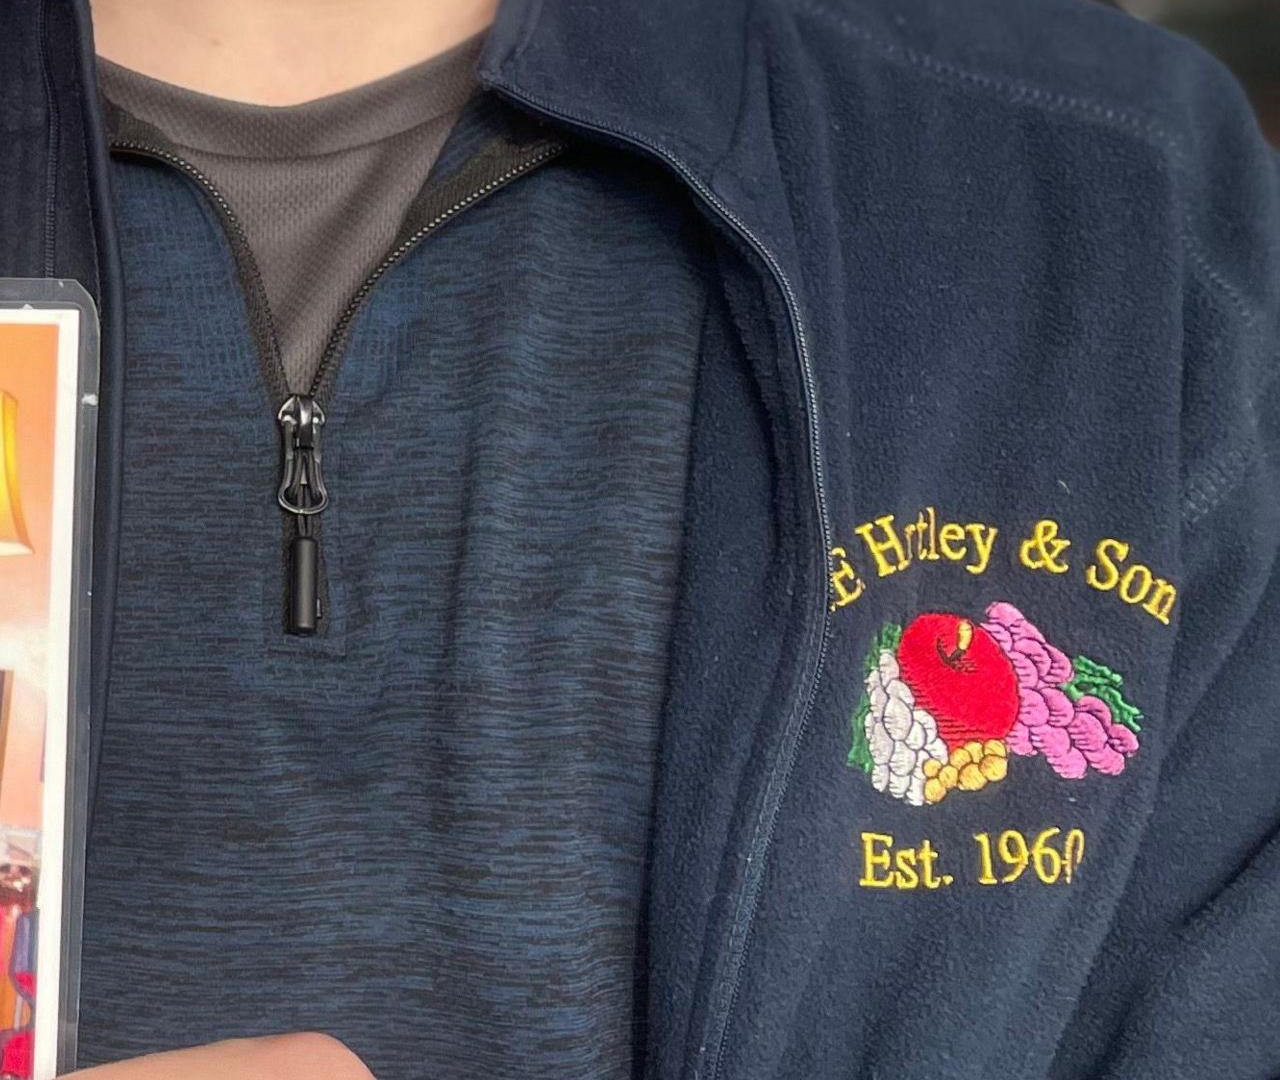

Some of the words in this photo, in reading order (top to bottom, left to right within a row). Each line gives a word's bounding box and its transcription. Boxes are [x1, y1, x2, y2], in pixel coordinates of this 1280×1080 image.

[1019, 520, 1071, 574] &
[1086, 538, 1177, 625] Son
[859, 832, 954, 889] Est.
